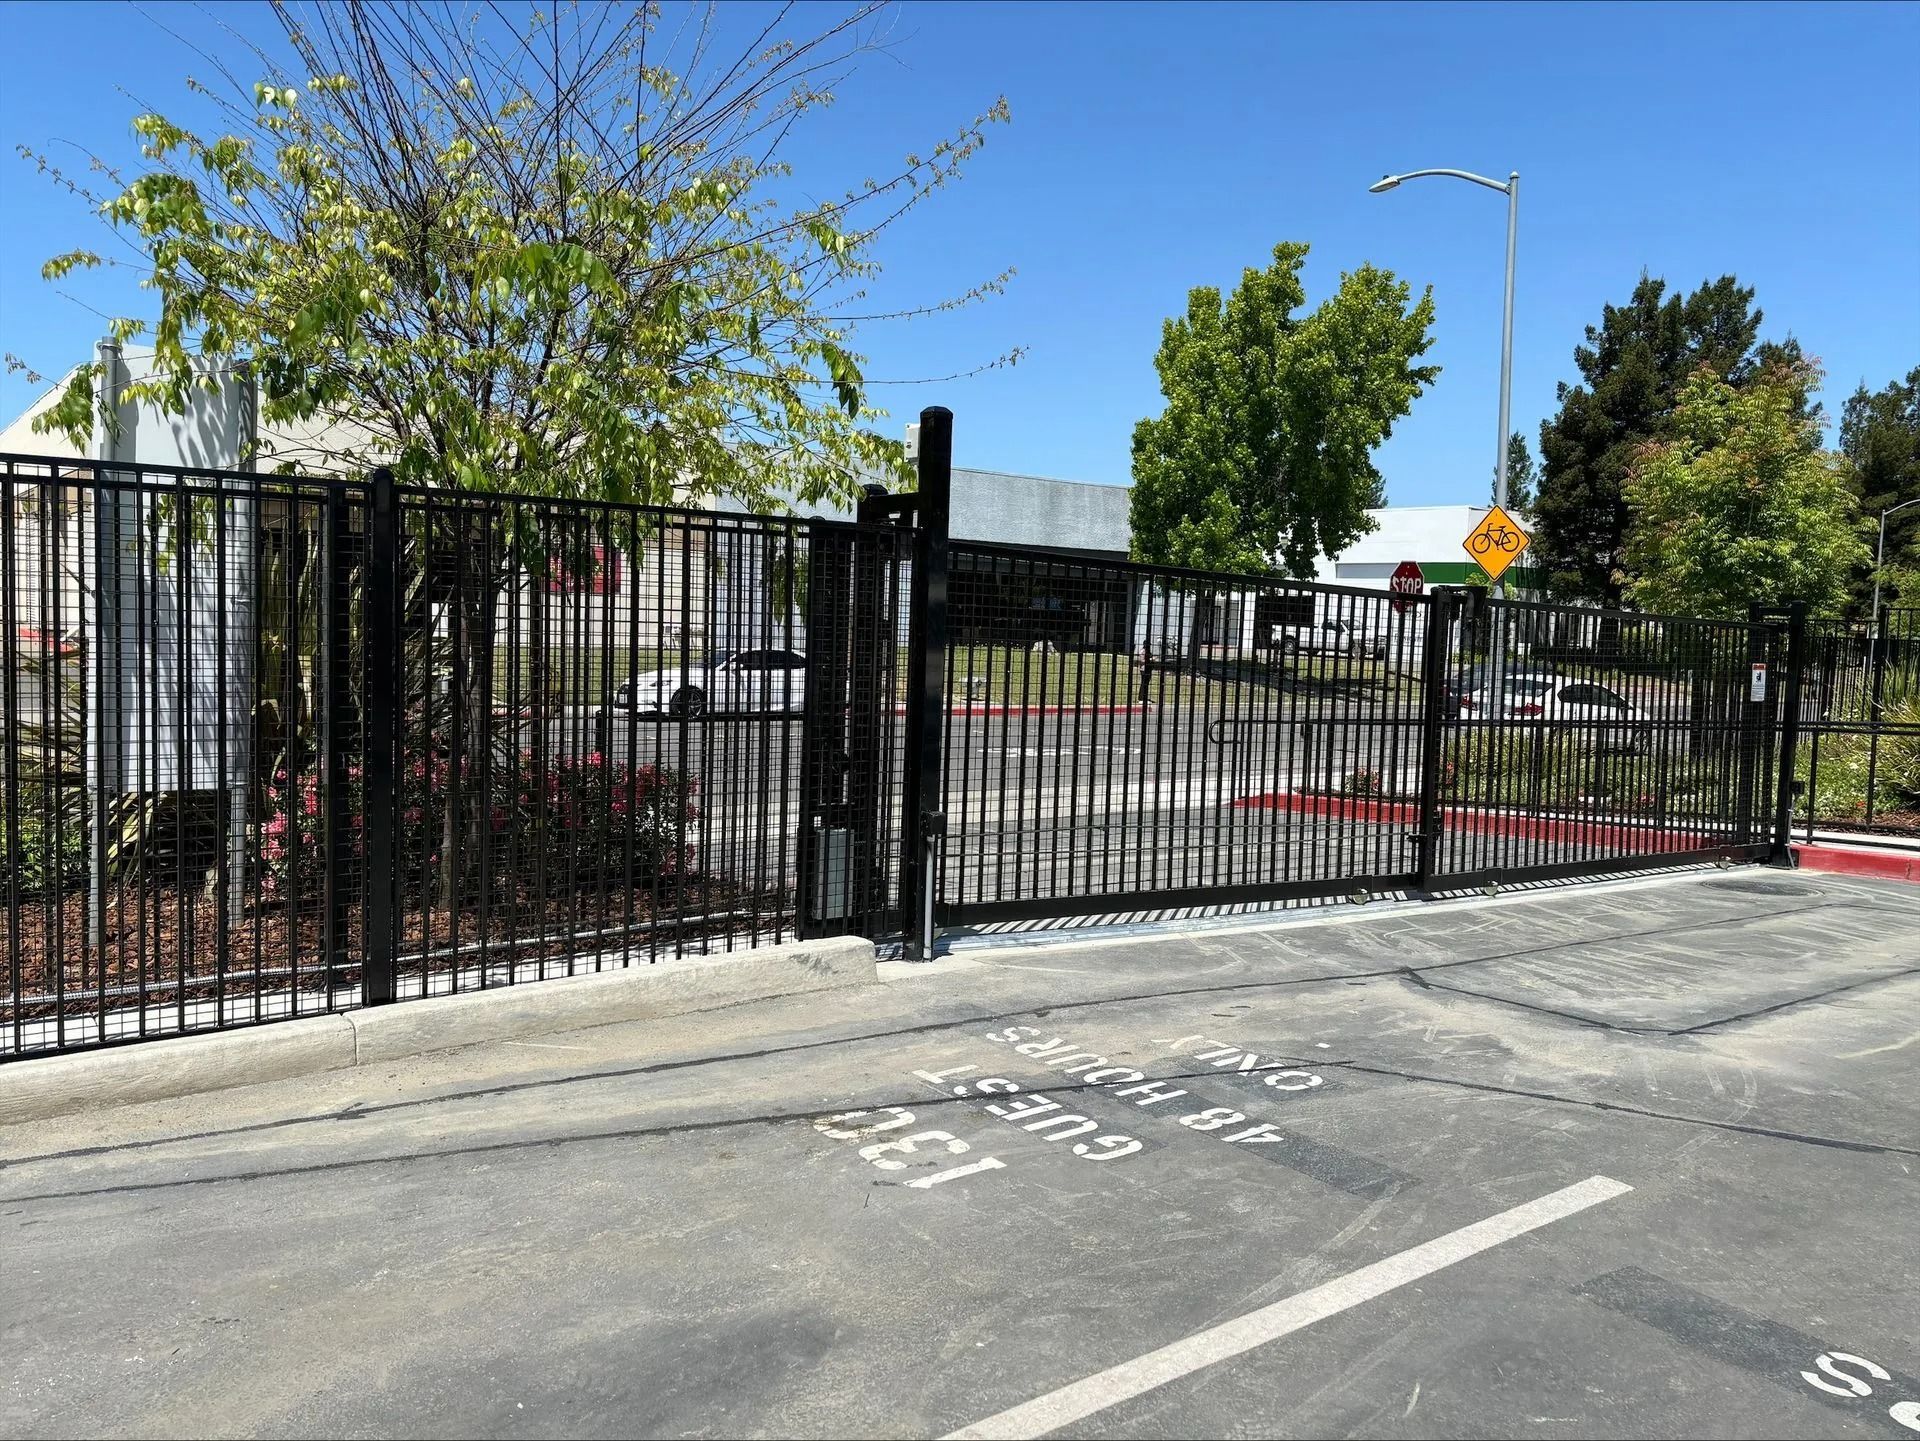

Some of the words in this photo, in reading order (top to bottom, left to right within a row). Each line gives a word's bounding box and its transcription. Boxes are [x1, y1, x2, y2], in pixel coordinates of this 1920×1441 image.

[1392, 576, 1422, 594] STOP
[985, 1025, 1188, 1107] HOURS
[1150, 1033, 1324, 1091] ONLY
[911, 1063, 1144, 1161] GUEST
[1179, 1106, 1285, 1144] 48
